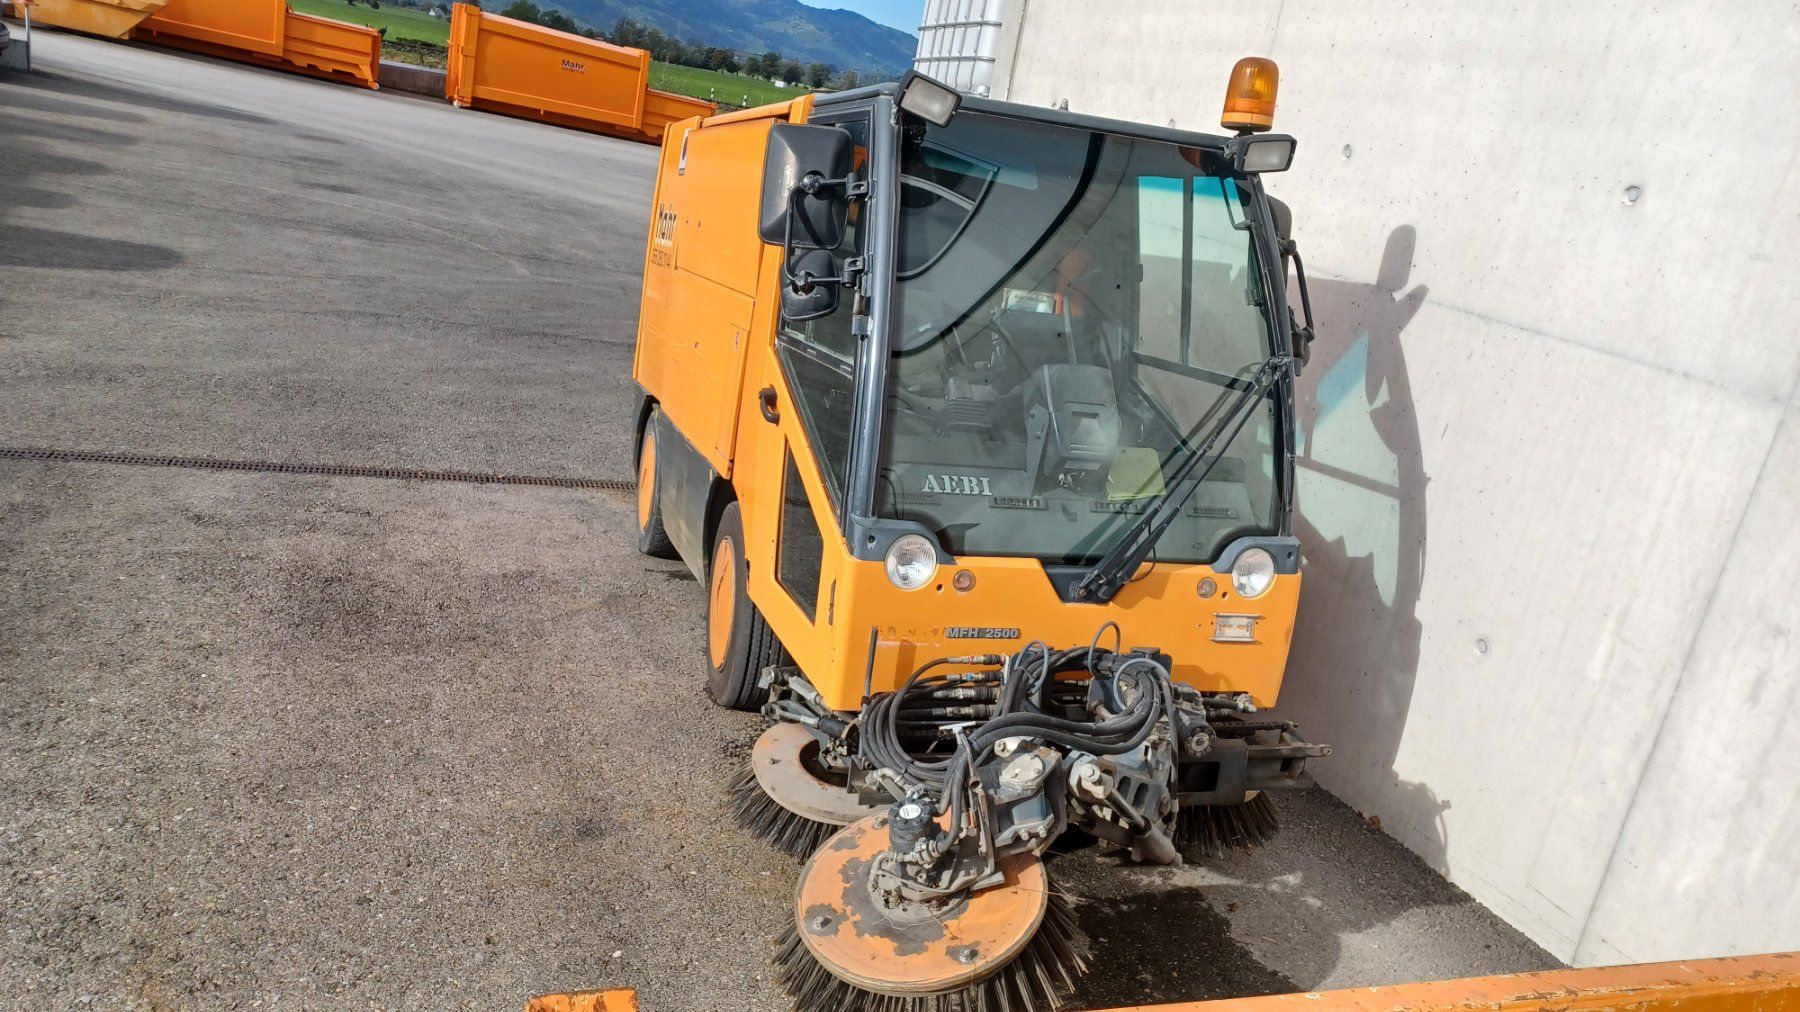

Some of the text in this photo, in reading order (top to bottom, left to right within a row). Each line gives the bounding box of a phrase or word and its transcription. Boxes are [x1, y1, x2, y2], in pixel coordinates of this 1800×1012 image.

[922, 474, 993, 496] AEBI
[945, 627, 1019, 639] MFH 2500
